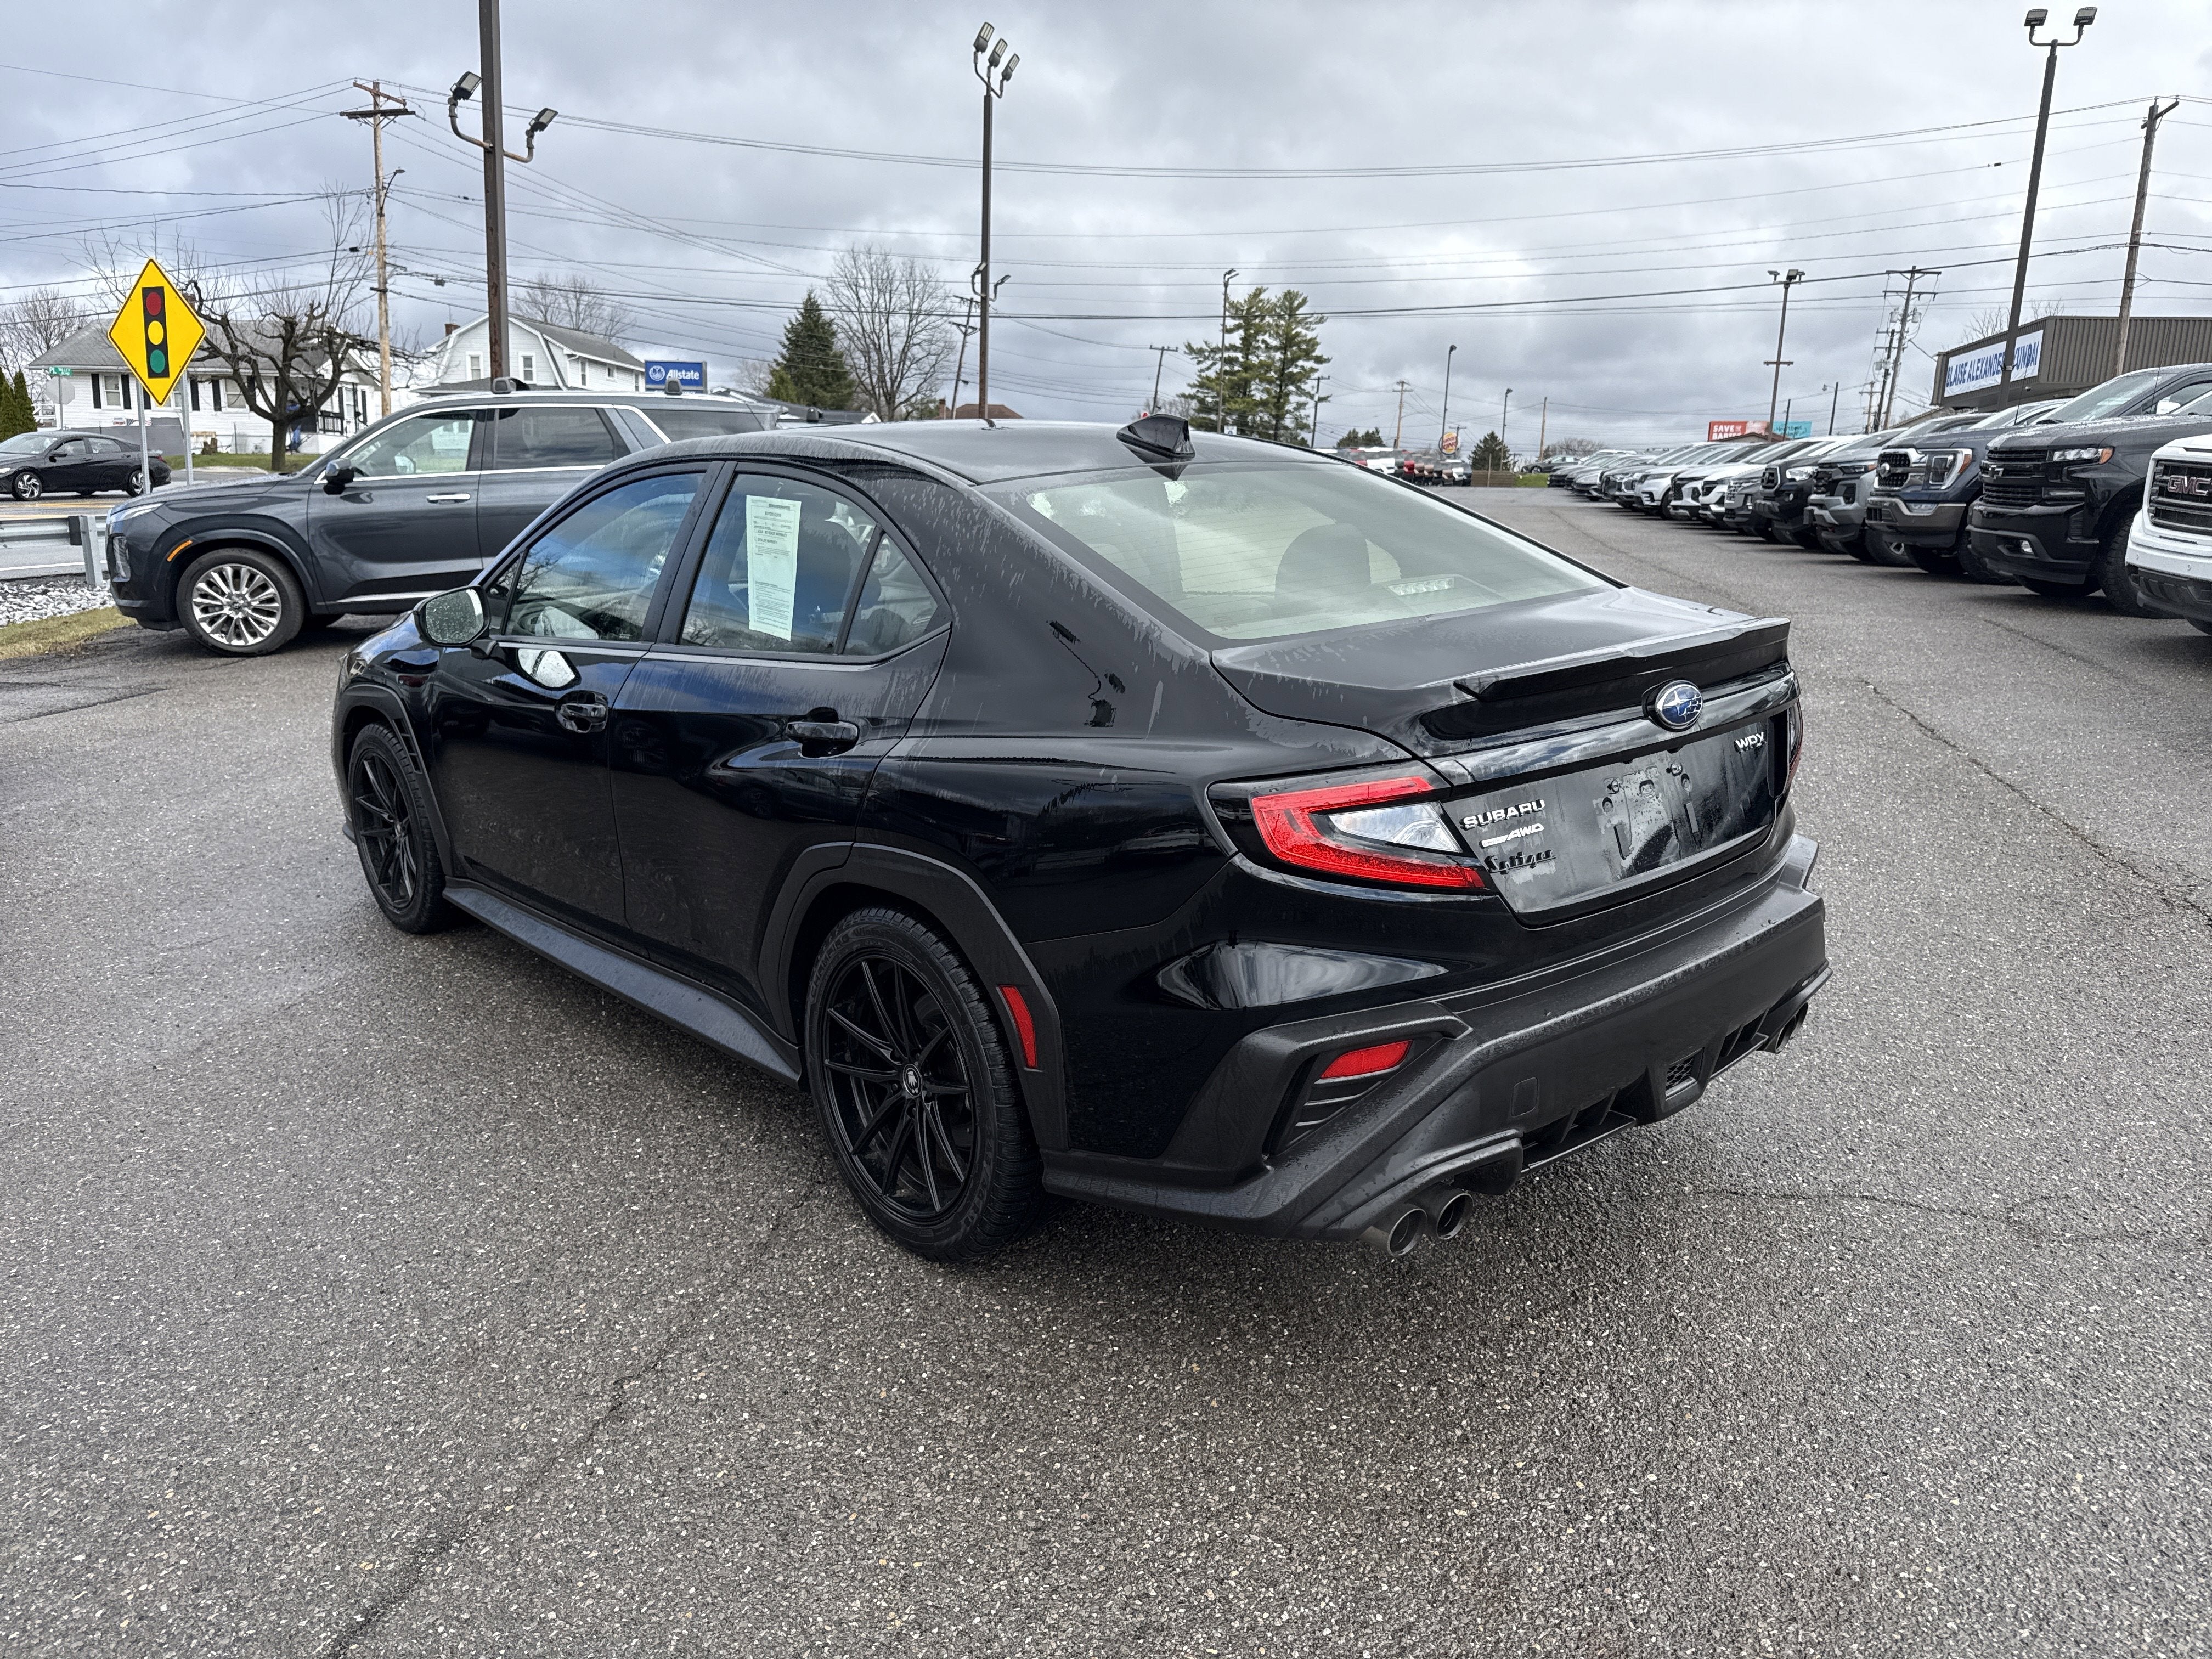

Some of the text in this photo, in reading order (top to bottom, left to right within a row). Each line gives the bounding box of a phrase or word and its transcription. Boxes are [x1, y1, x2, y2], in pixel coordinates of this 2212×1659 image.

[666, 369, 700, 380] Allstate
[1946, 363, 1967, 387] BLAISE
[1713, 424, 1735, 432] SAVE
[2167, 475, 2211, 496] GMC
[1461, 799, 1546, 830] SUBARU
[1506, 823, 1544, 840] AWD
